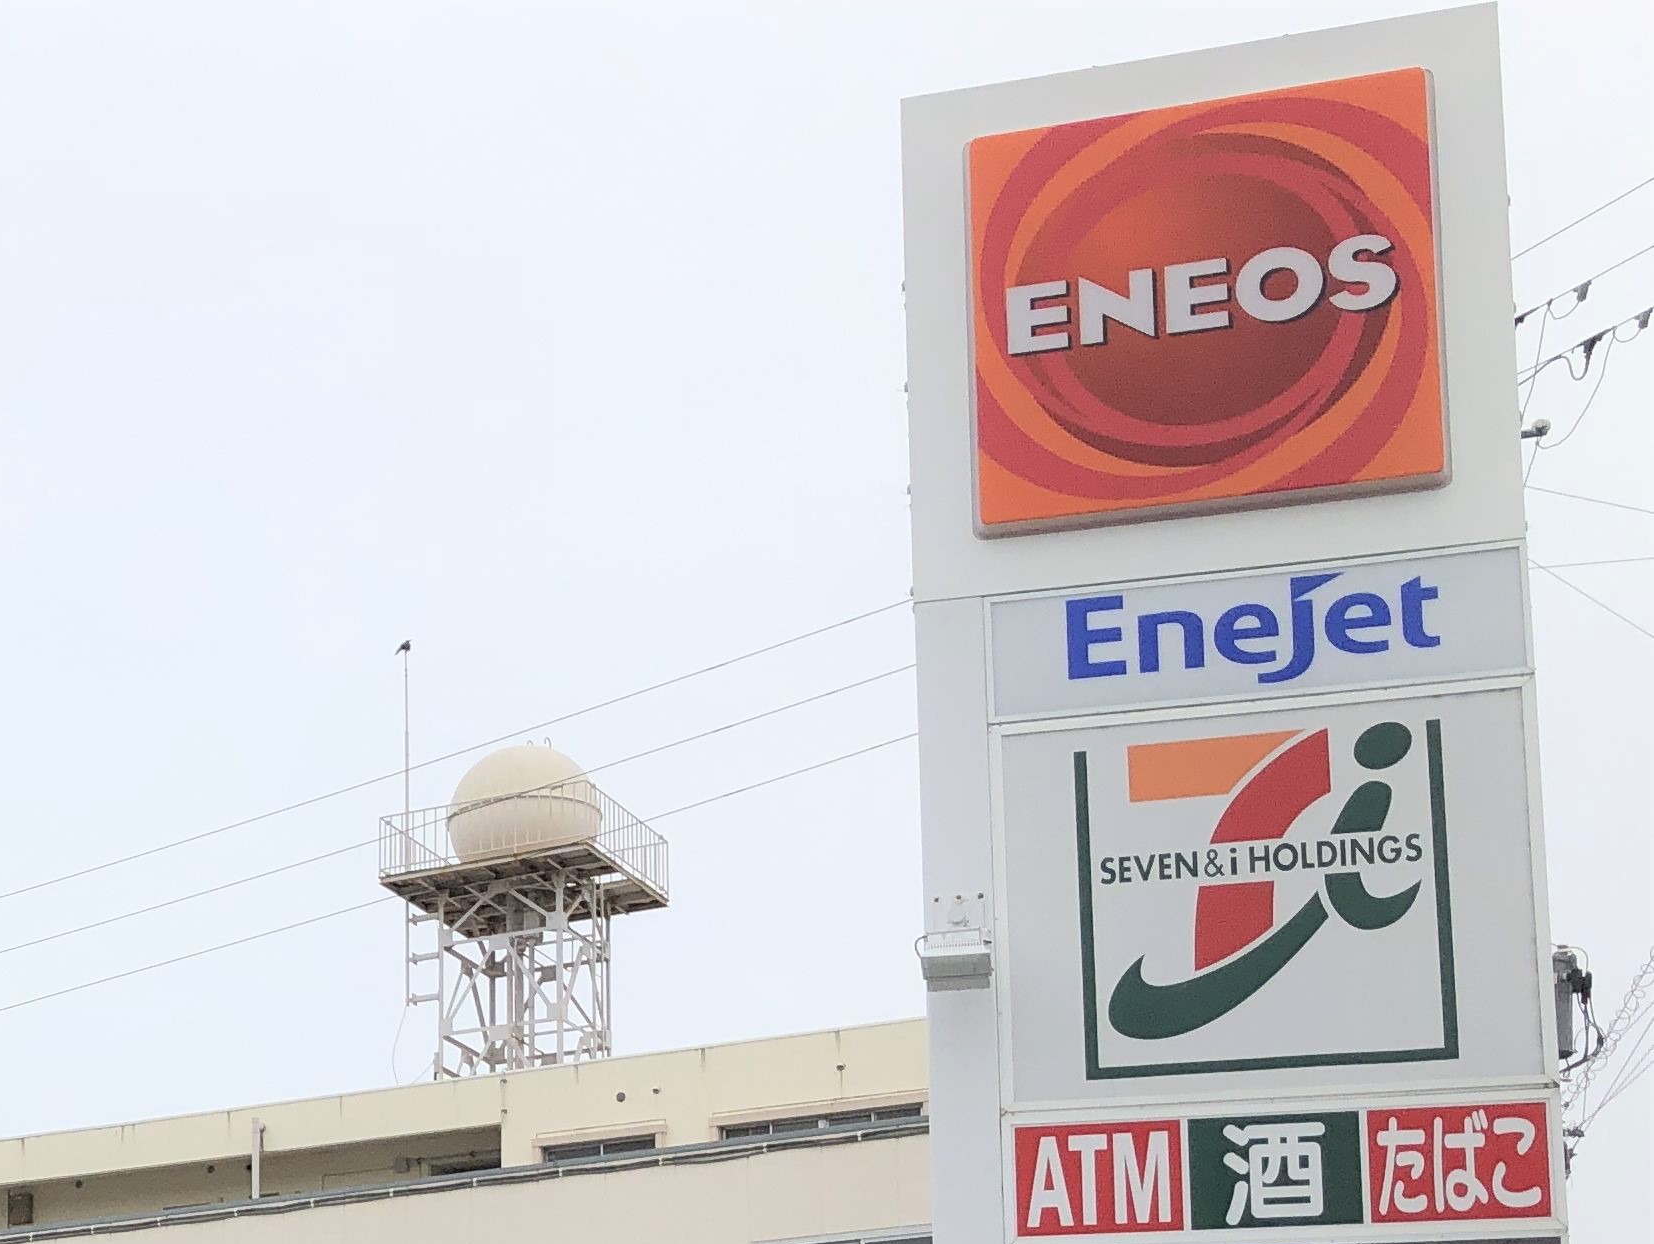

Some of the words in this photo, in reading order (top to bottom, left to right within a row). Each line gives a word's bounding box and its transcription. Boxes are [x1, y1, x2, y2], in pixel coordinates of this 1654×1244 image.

[1005, 233, 1400, 356] ENEOS
[1066, 572, 1441, 684] Enejet
[1249, 833, 1423, 874] HOLDINGS
[1027, 1130, 1173, 1228] ATM
[1222, 1121, 1325, 1225] 酒
[1376, 1109, 1542, 1215] たばこ
